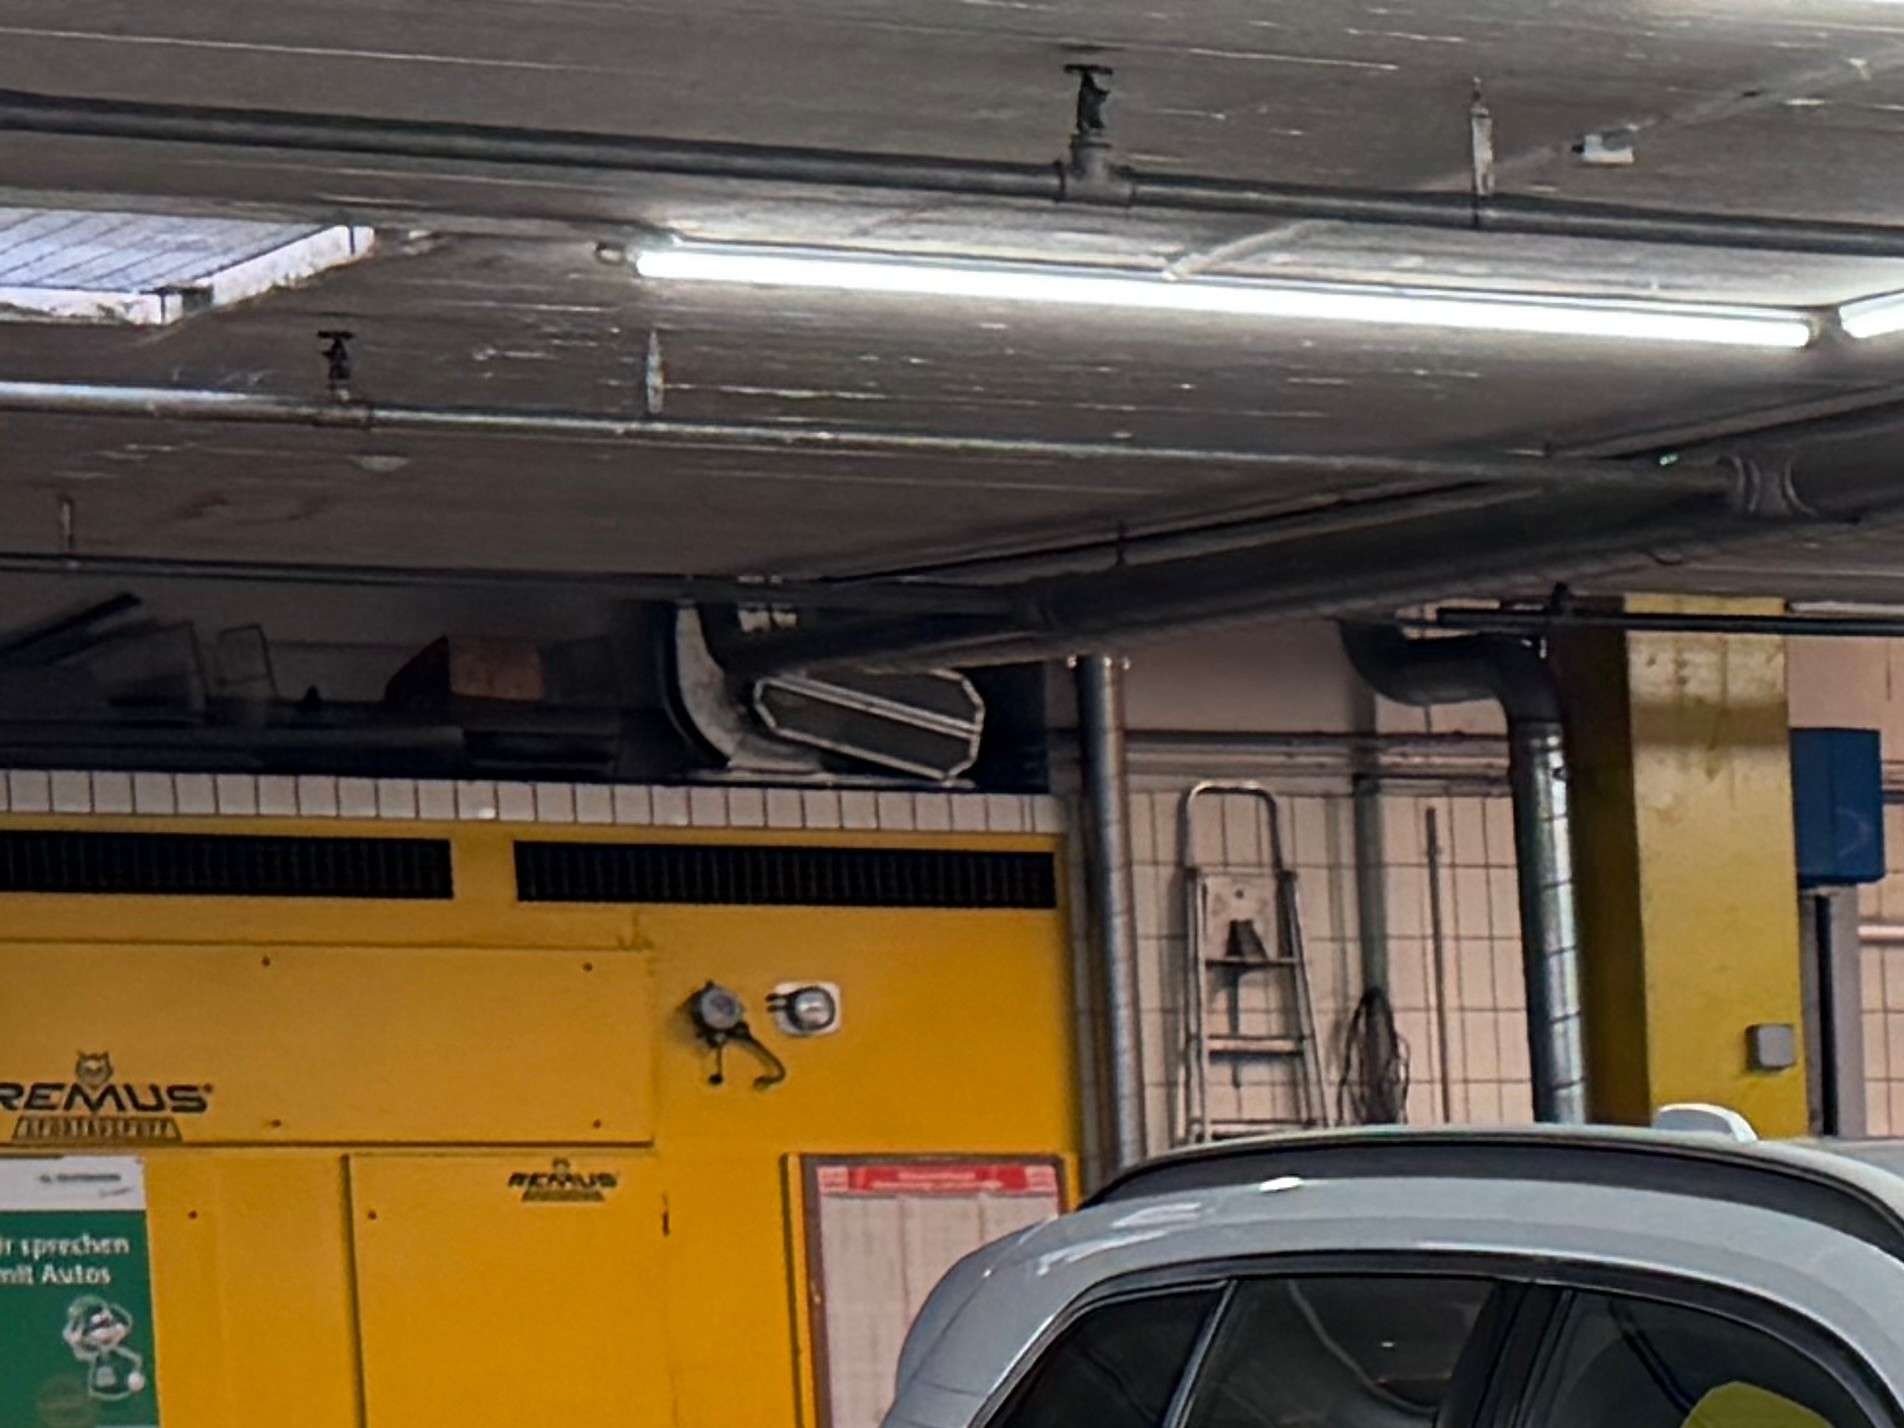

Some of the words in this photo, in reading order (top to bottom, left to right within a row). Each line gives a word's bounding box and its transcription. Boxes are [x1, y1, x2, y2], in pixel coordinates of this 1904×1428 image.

[0, 1082, 207, 1113] REMUS
[21, 1233, 130, 1260] sprechen
[42, 1263, 111, 1284] Autos
